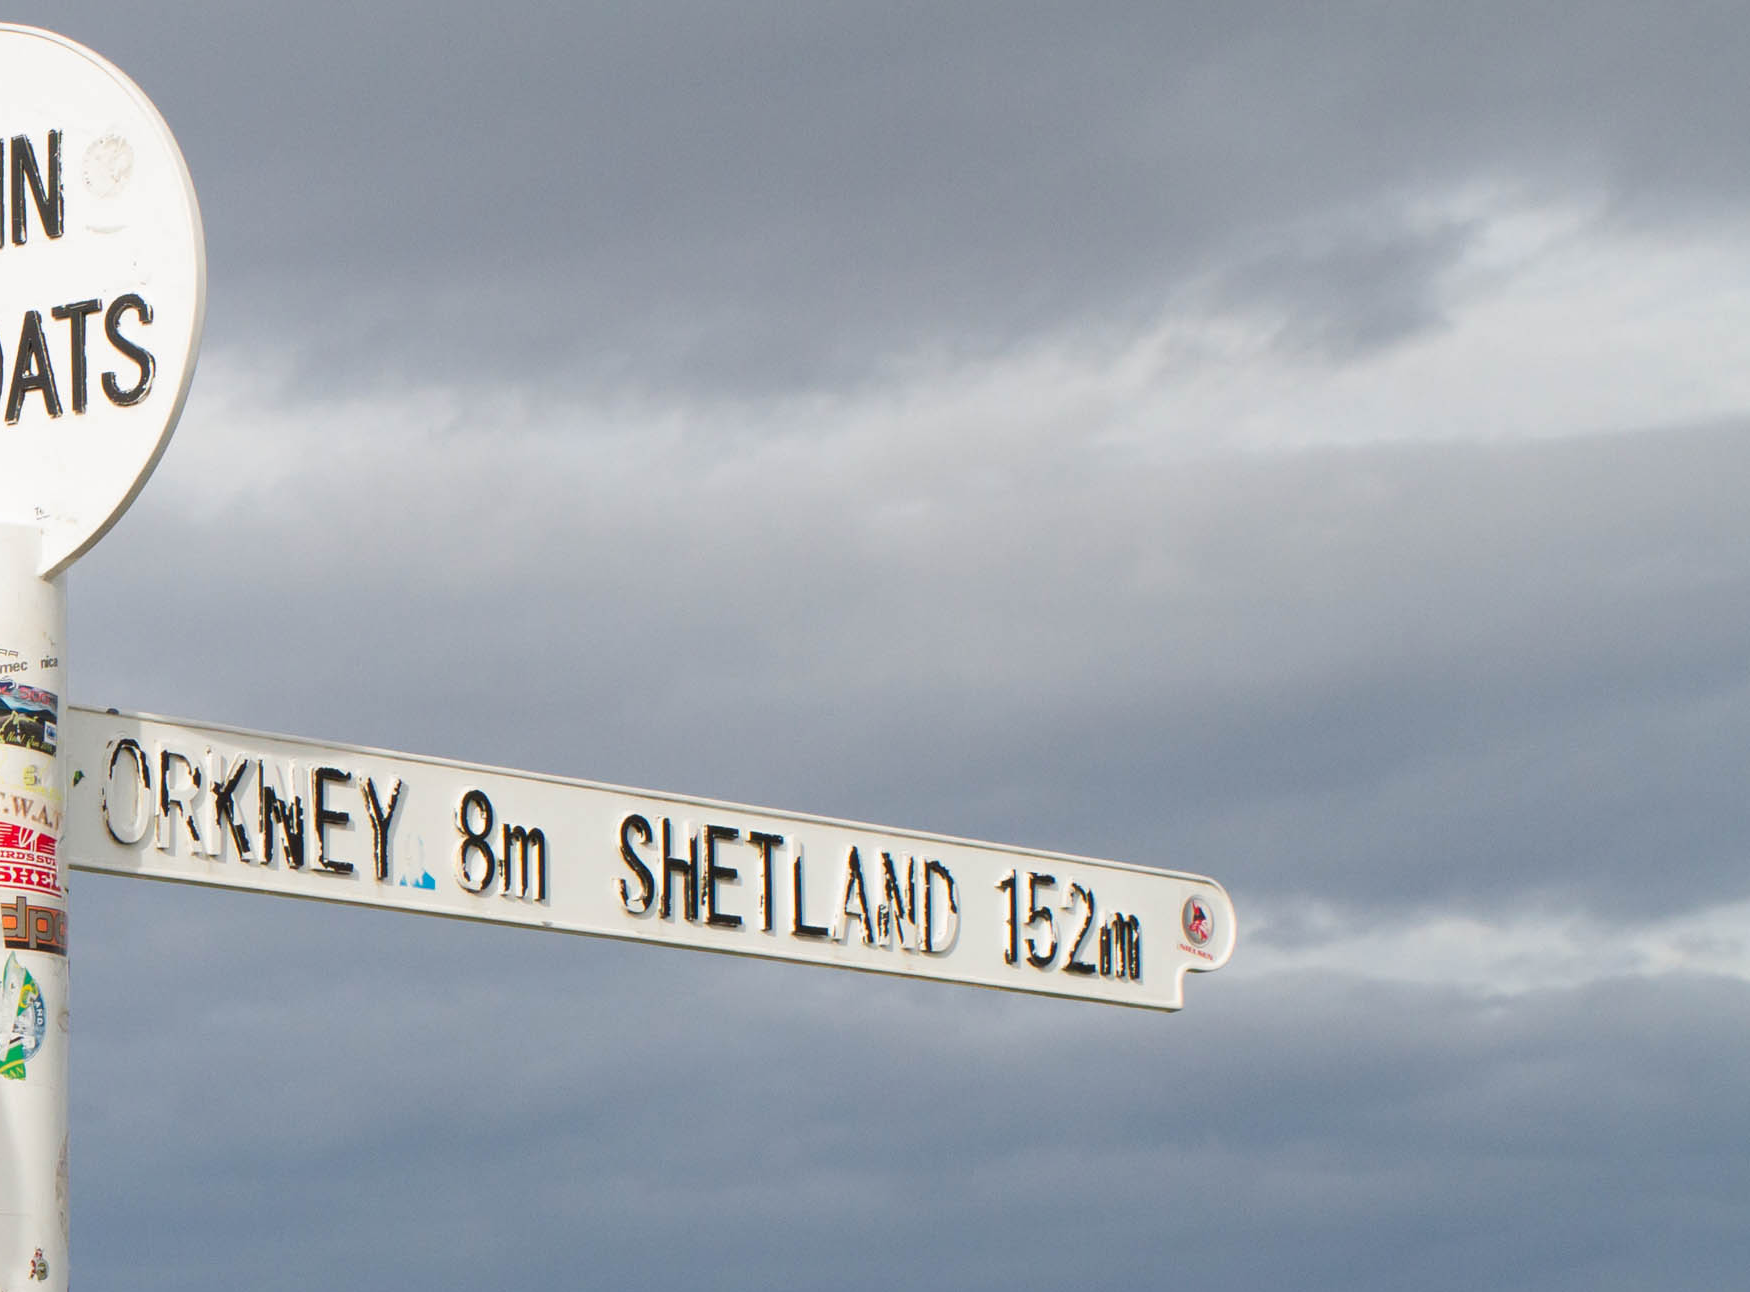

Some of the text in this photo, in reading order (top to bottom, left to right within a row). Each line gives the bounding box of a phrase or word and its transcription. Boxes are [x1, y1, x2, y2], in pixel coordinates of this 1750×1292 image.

[101, 732, 1141, 983] ORKNEY 8m SHETLAND 152m
